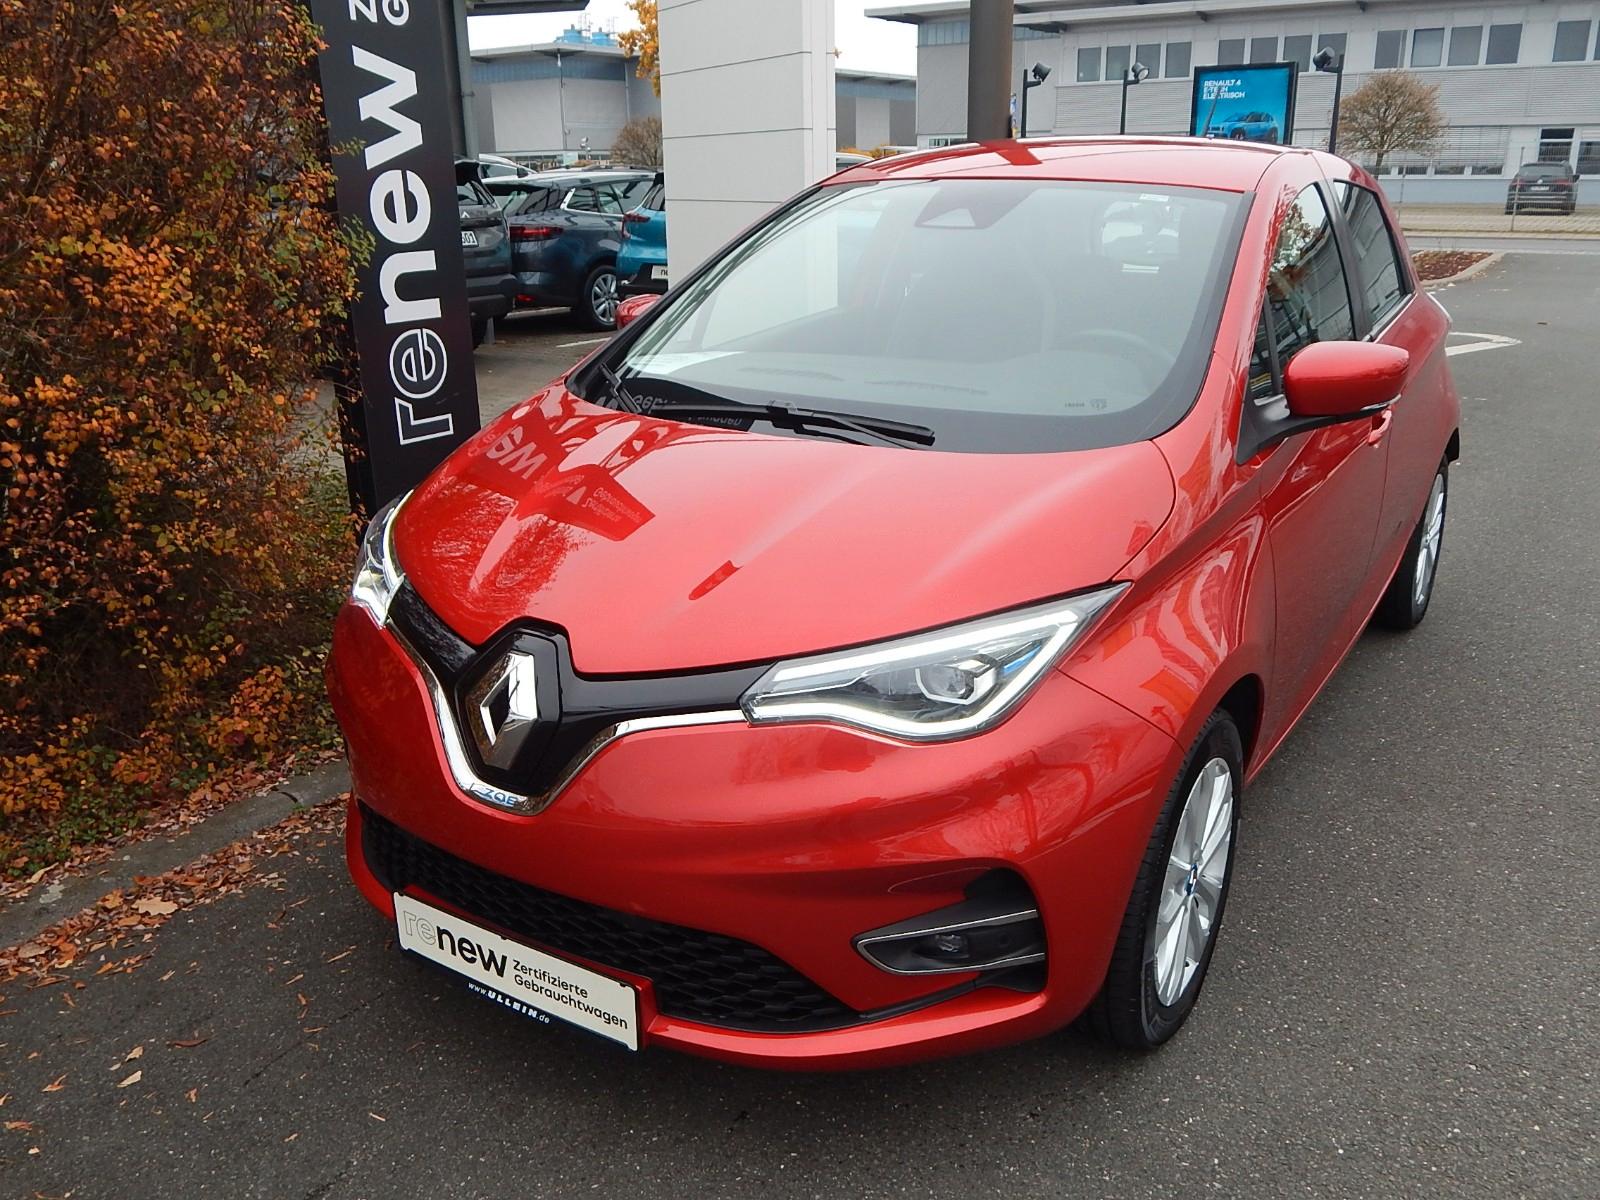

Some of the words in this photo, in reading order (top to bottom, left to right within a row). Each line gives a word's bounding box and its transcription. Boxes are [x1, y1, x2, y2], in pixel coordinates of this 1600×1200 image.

[1203, 91, 1246, 99] ELETRISCH
[1204, 79, 1235, 87] RENAULT
[1235, 79, 1242, 87] 4
[352, 44, 454, 445] renew
[403, 910, 508, 978] renew
[512, 959, 588, 999] Zertifizierte
[513, 974, 628, 1030] Gebrauchtwagen
